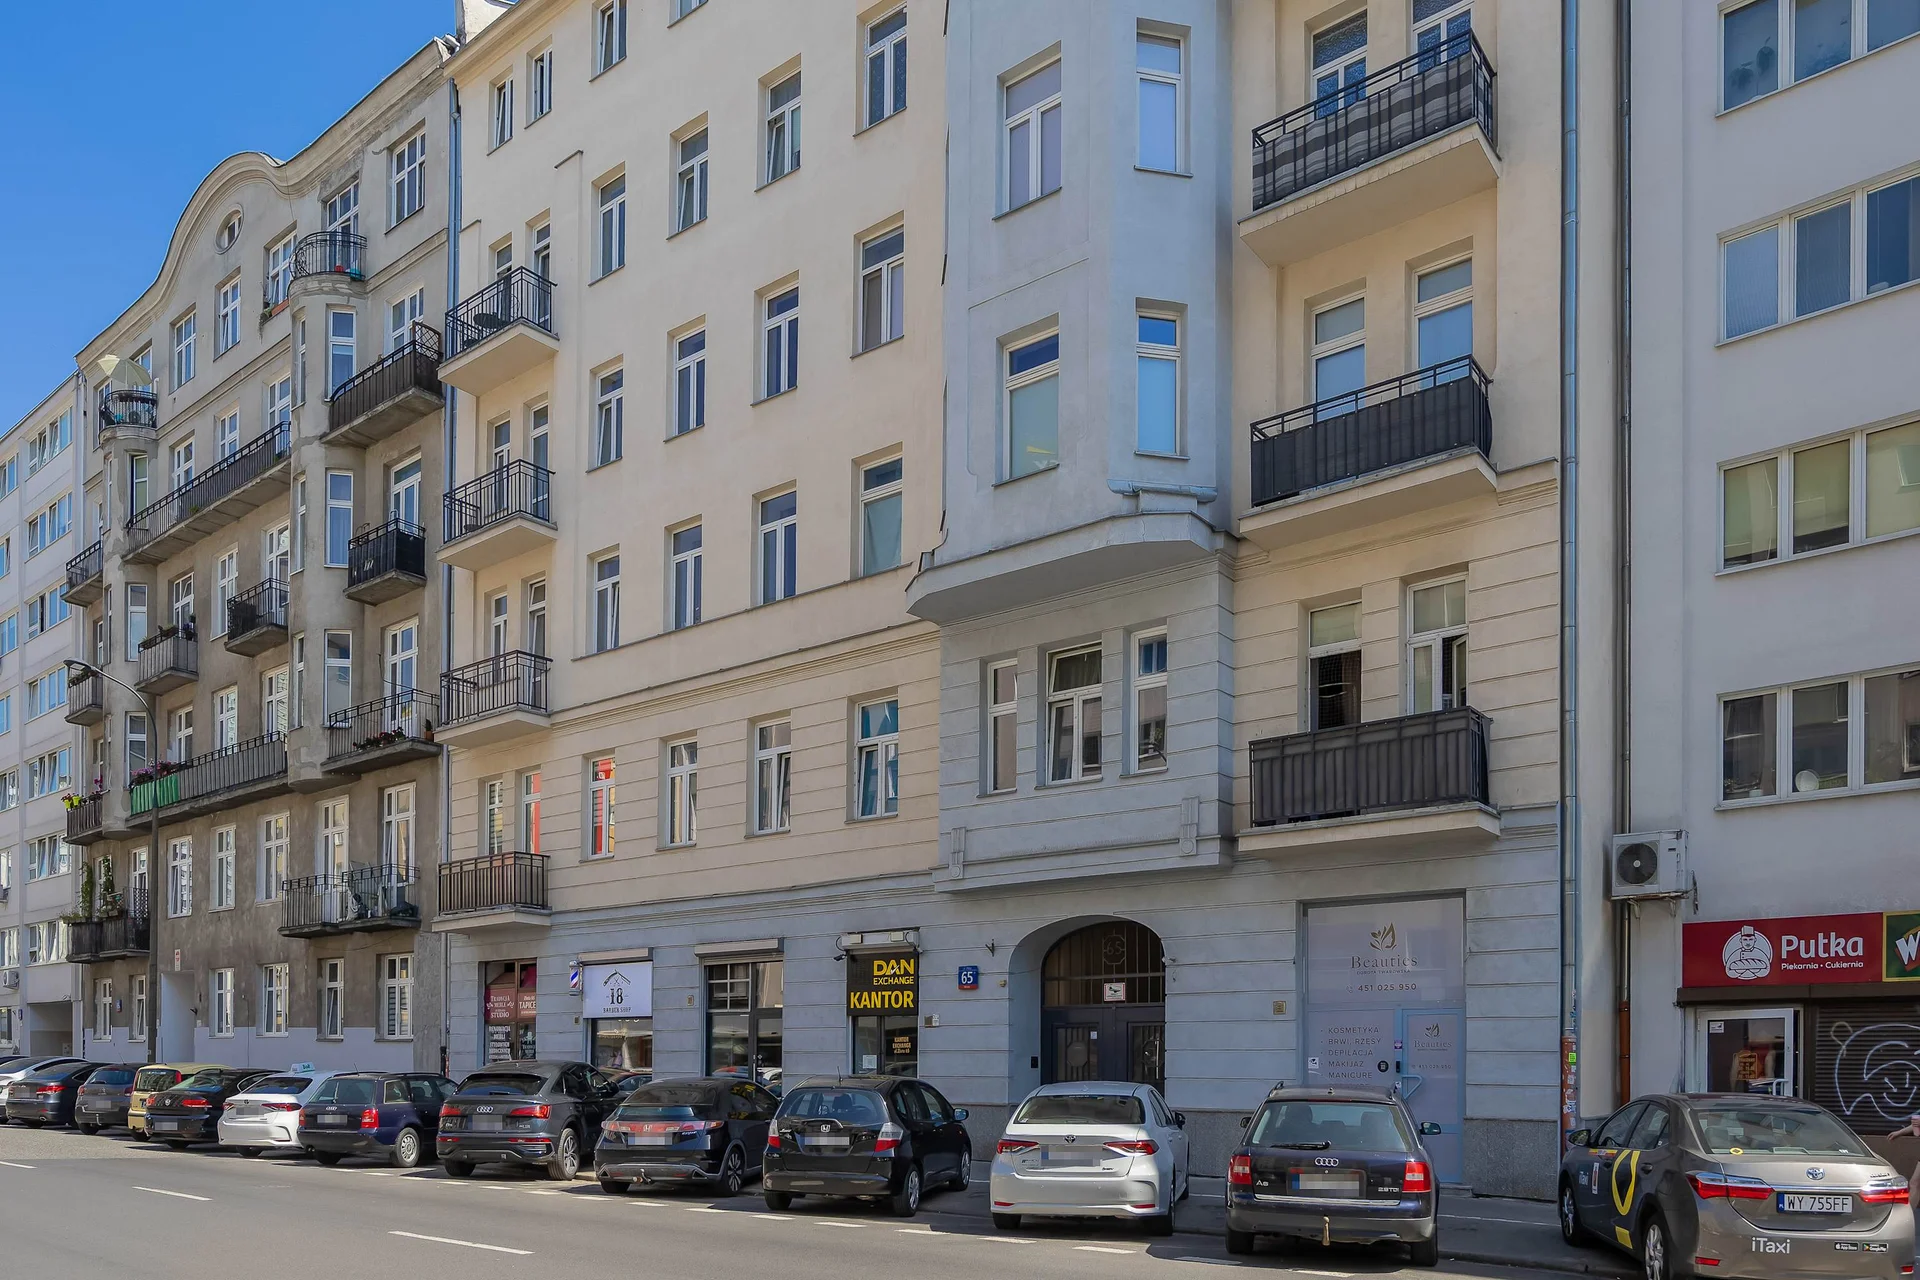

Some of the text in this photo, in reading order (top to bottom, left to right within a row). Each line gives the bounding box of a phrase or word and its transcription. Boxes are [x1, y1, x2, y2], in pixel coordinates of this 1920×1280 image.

[1106, 941, 1122, 955] 65
[1781, 932, 1864, 960] Putka
[873, 959, 914, 976] DAN
[1351, 954, 1418, 969] Beauties
[1781, 961, 1864, 970] Piekarnia Cukiernia
[873, 976, 914, 986] EXCHANGE
[961, 971, 974, 984] 65
[1358, 984, 1373, 992] 451
[1398, 983, 1417, 991] 950
[610, 987, 624, 1005] 18
[850, 990, 914, 1009] KANTOR
[1328, 1026, 1379, 1034] KOSMETYKA
[1414, 1040, 1452, 1048] Beauties
[1787, 1195, 1849, 1211] WY 755FF
[1752, 1237, 1790, 1254] iTaxi
